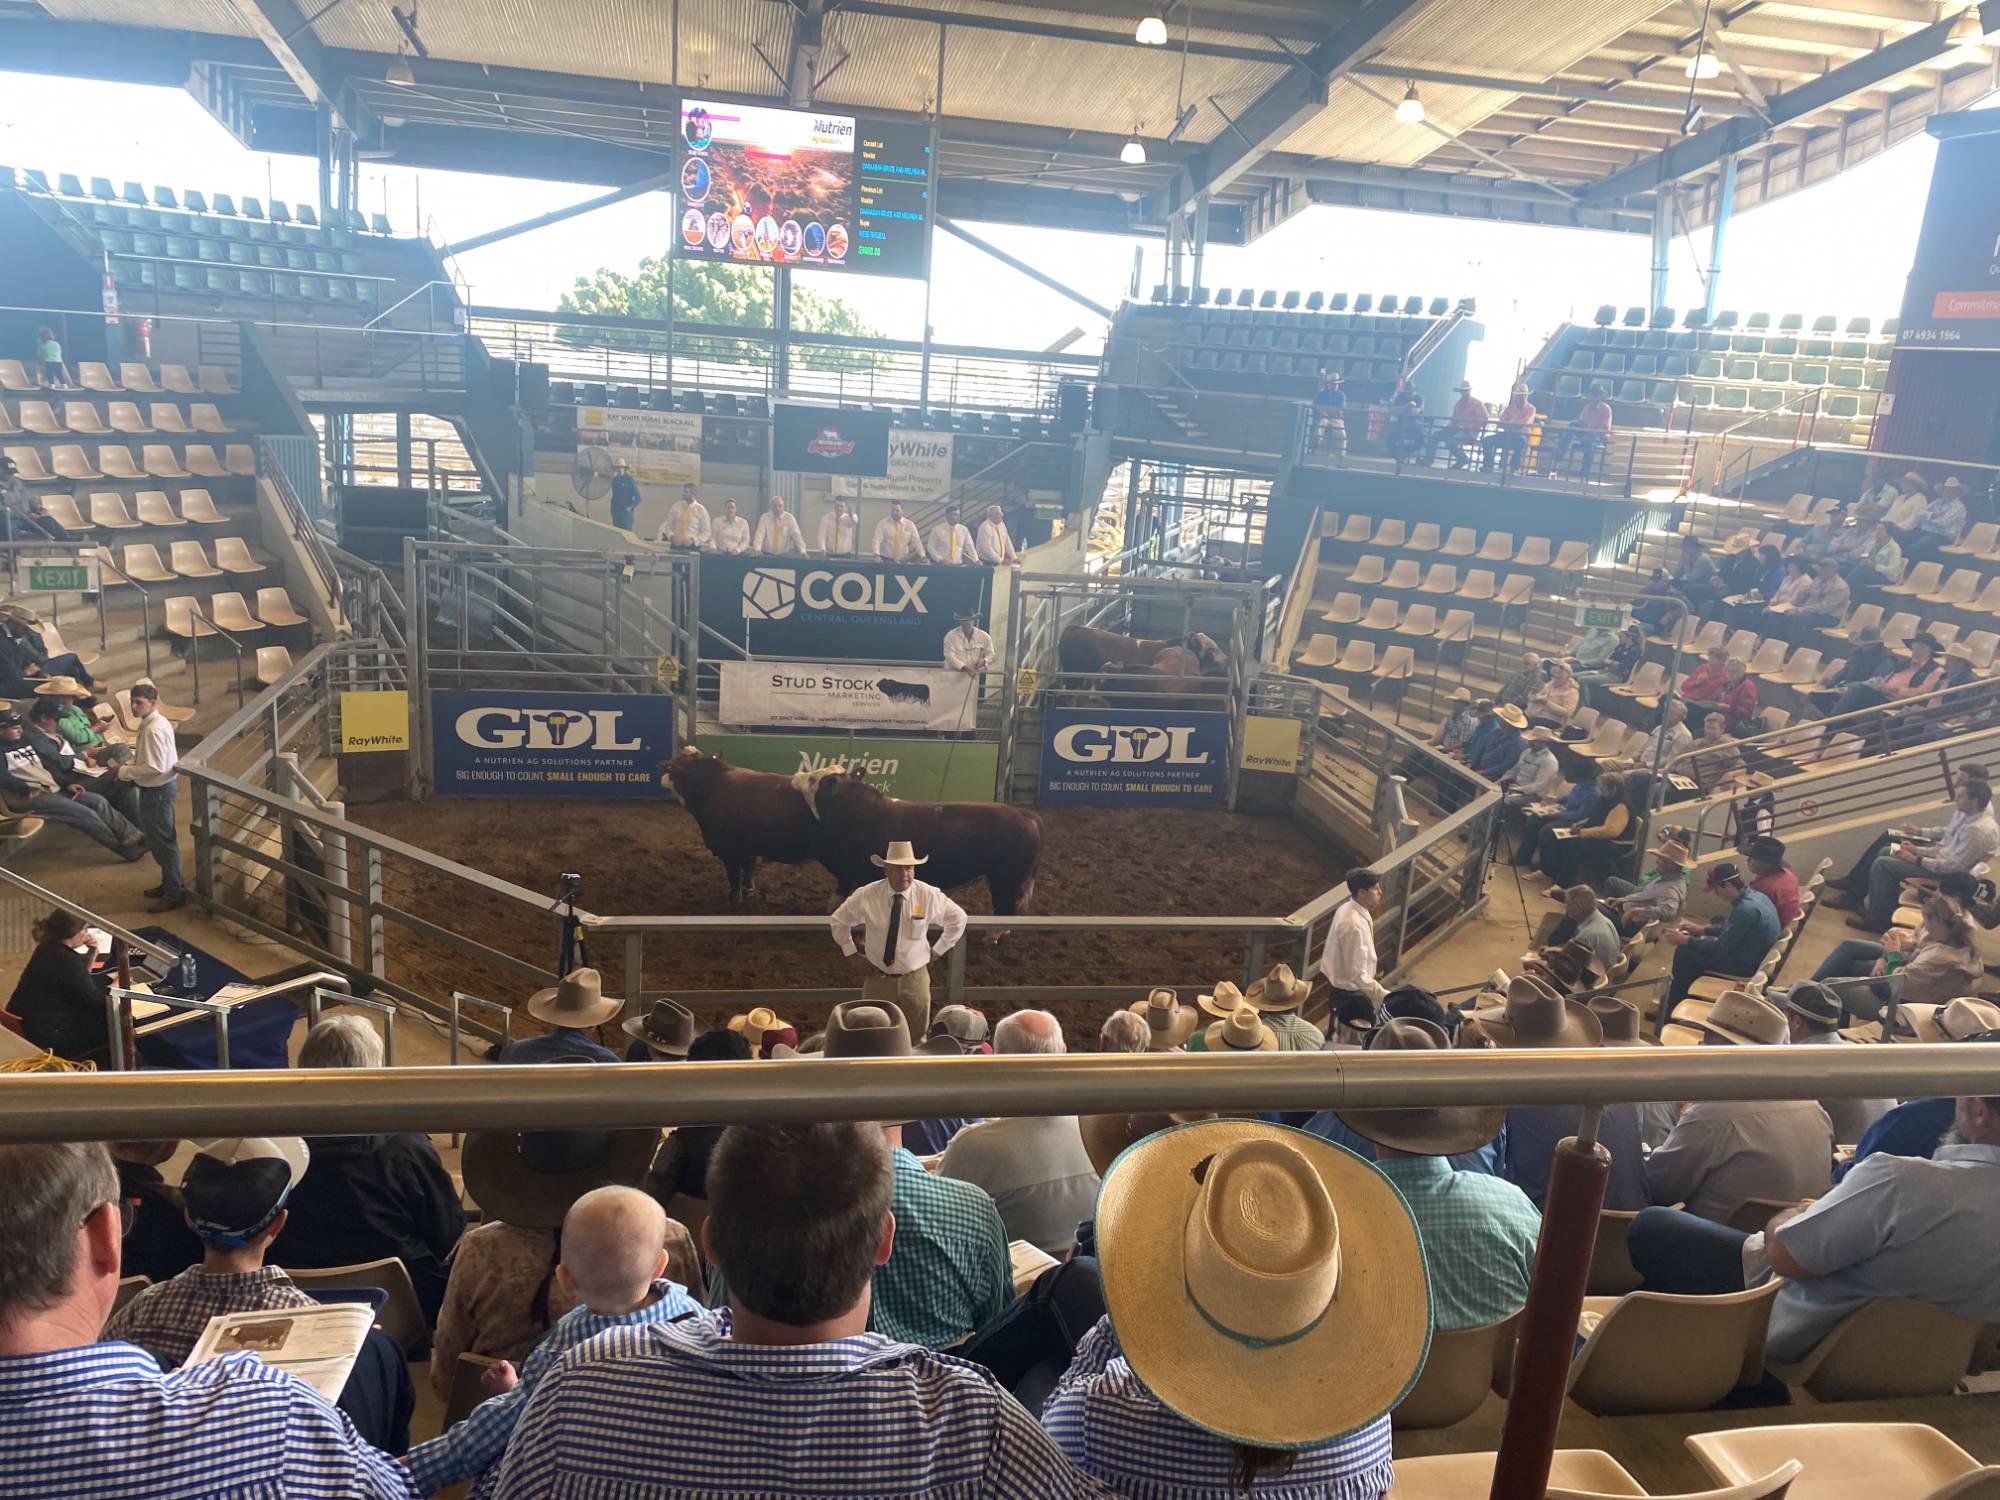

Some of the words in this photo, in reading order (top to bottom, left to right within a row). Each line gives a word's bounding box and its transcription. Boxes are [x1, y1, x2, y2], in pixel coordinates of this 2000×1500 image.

[813, 119, 853, 137] Nutrien
[1902, 329, 1913, 340] 07
[607, 413, 619, 421] RAY
[641, 416, 661, 424] RURAL
[662, 418, 694, 426] BLACKALL
[45, 569, 81, 587] EXIT
[801, 570, 928, 613] CQLX
[800, 613, 848, 624] CENTRAL
[851, 614, 922, 626] QUEENSLAND
[1589, 611, 1613, 626] EXIT
[772, 675, 816, 689] STUD
[822, 677, 874, 691] STOCK
[828, 692, 881, 701] MARKETING
[455, 706, 642, 751] GDL
[348, 734, 403, 748] RayWhite
[1053, 723, 1209, 764] GDL
[484, 757, 524, 765] NUTRIEN
[541, 758, 592, 766] SOLUTIONS
[595, 759, 634, 767] PARTNER
[1246, 755, 1292, 768] RayWhite
[456, 770, 471, 780] BIG
[471, 771, 504, 781] ENOUGH
[506, 771, 516, 781] TO
[547, 772, 575, 782] SMALL
[577, 772, 612, 782] ENOUGH
[615, 773, 626, 782] TO
[628, 773, 651, 783] CARE
[1050, 782, 1062, 791] BIG
[1063, 782, 1090, 791] ENOUGH
[1091, 782, 1100, 791] TO
[1125, 783, 1149, 792] SMALL
[1151, 784, 1182, 793] ENOUGH
[1183, 784, 1192, 793] TO
[1194, 784, 1213, 793] CARE
